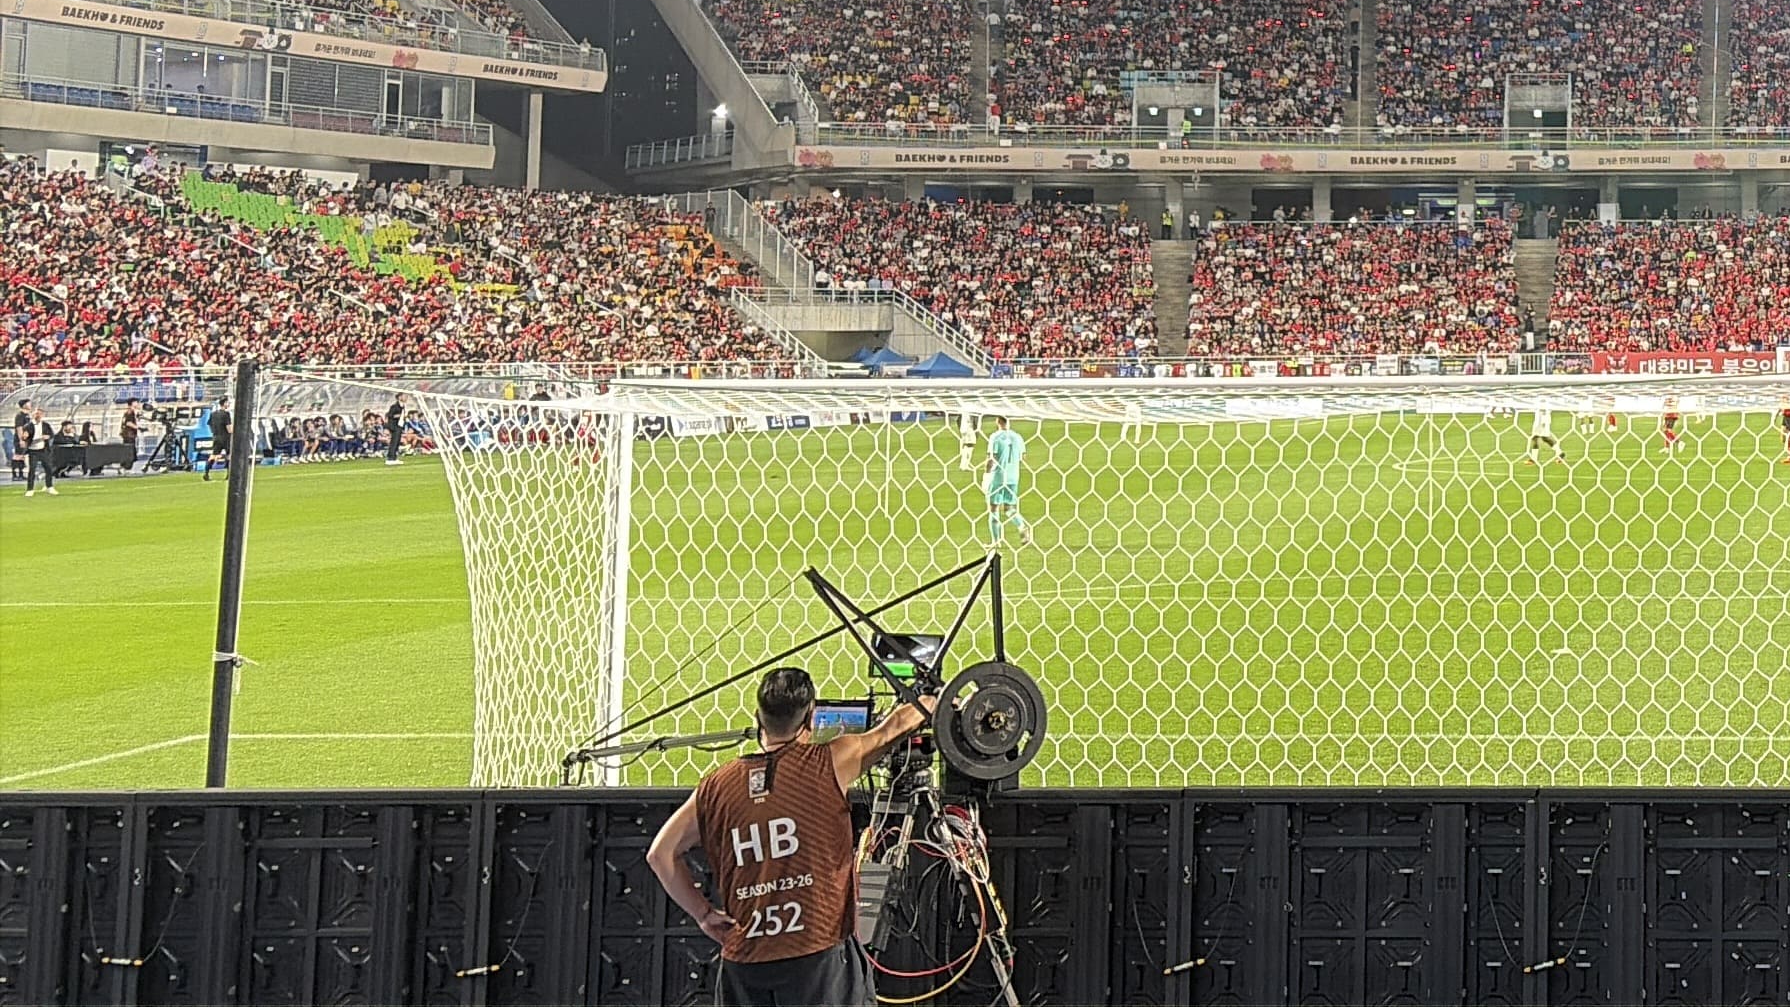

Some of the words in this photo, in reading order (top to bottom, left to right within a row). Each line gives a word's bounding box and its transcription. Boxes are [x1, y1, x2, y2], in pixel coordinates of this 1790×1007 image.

[110, 13, 118, 24] &
[119, 14, 165, 31] FRIENDS
[518, 67, 524, 76] &
[525, 69, 558, 81] FRIENDS
[949, 154, 957, 163] &
[959, 154, 1009, 163] FRIENDS
[1400, 156, 1408, 165] &
[1410, 156, 1457, 165] FRIENDS
[1639, 358, 1715, 374] 대한민국
[731, 817, 799, 867] HB
[736, 879, 778, 901] SEASON
[779, 873, 814, 893] 23-26
[746, 901, 804, 939] 252
